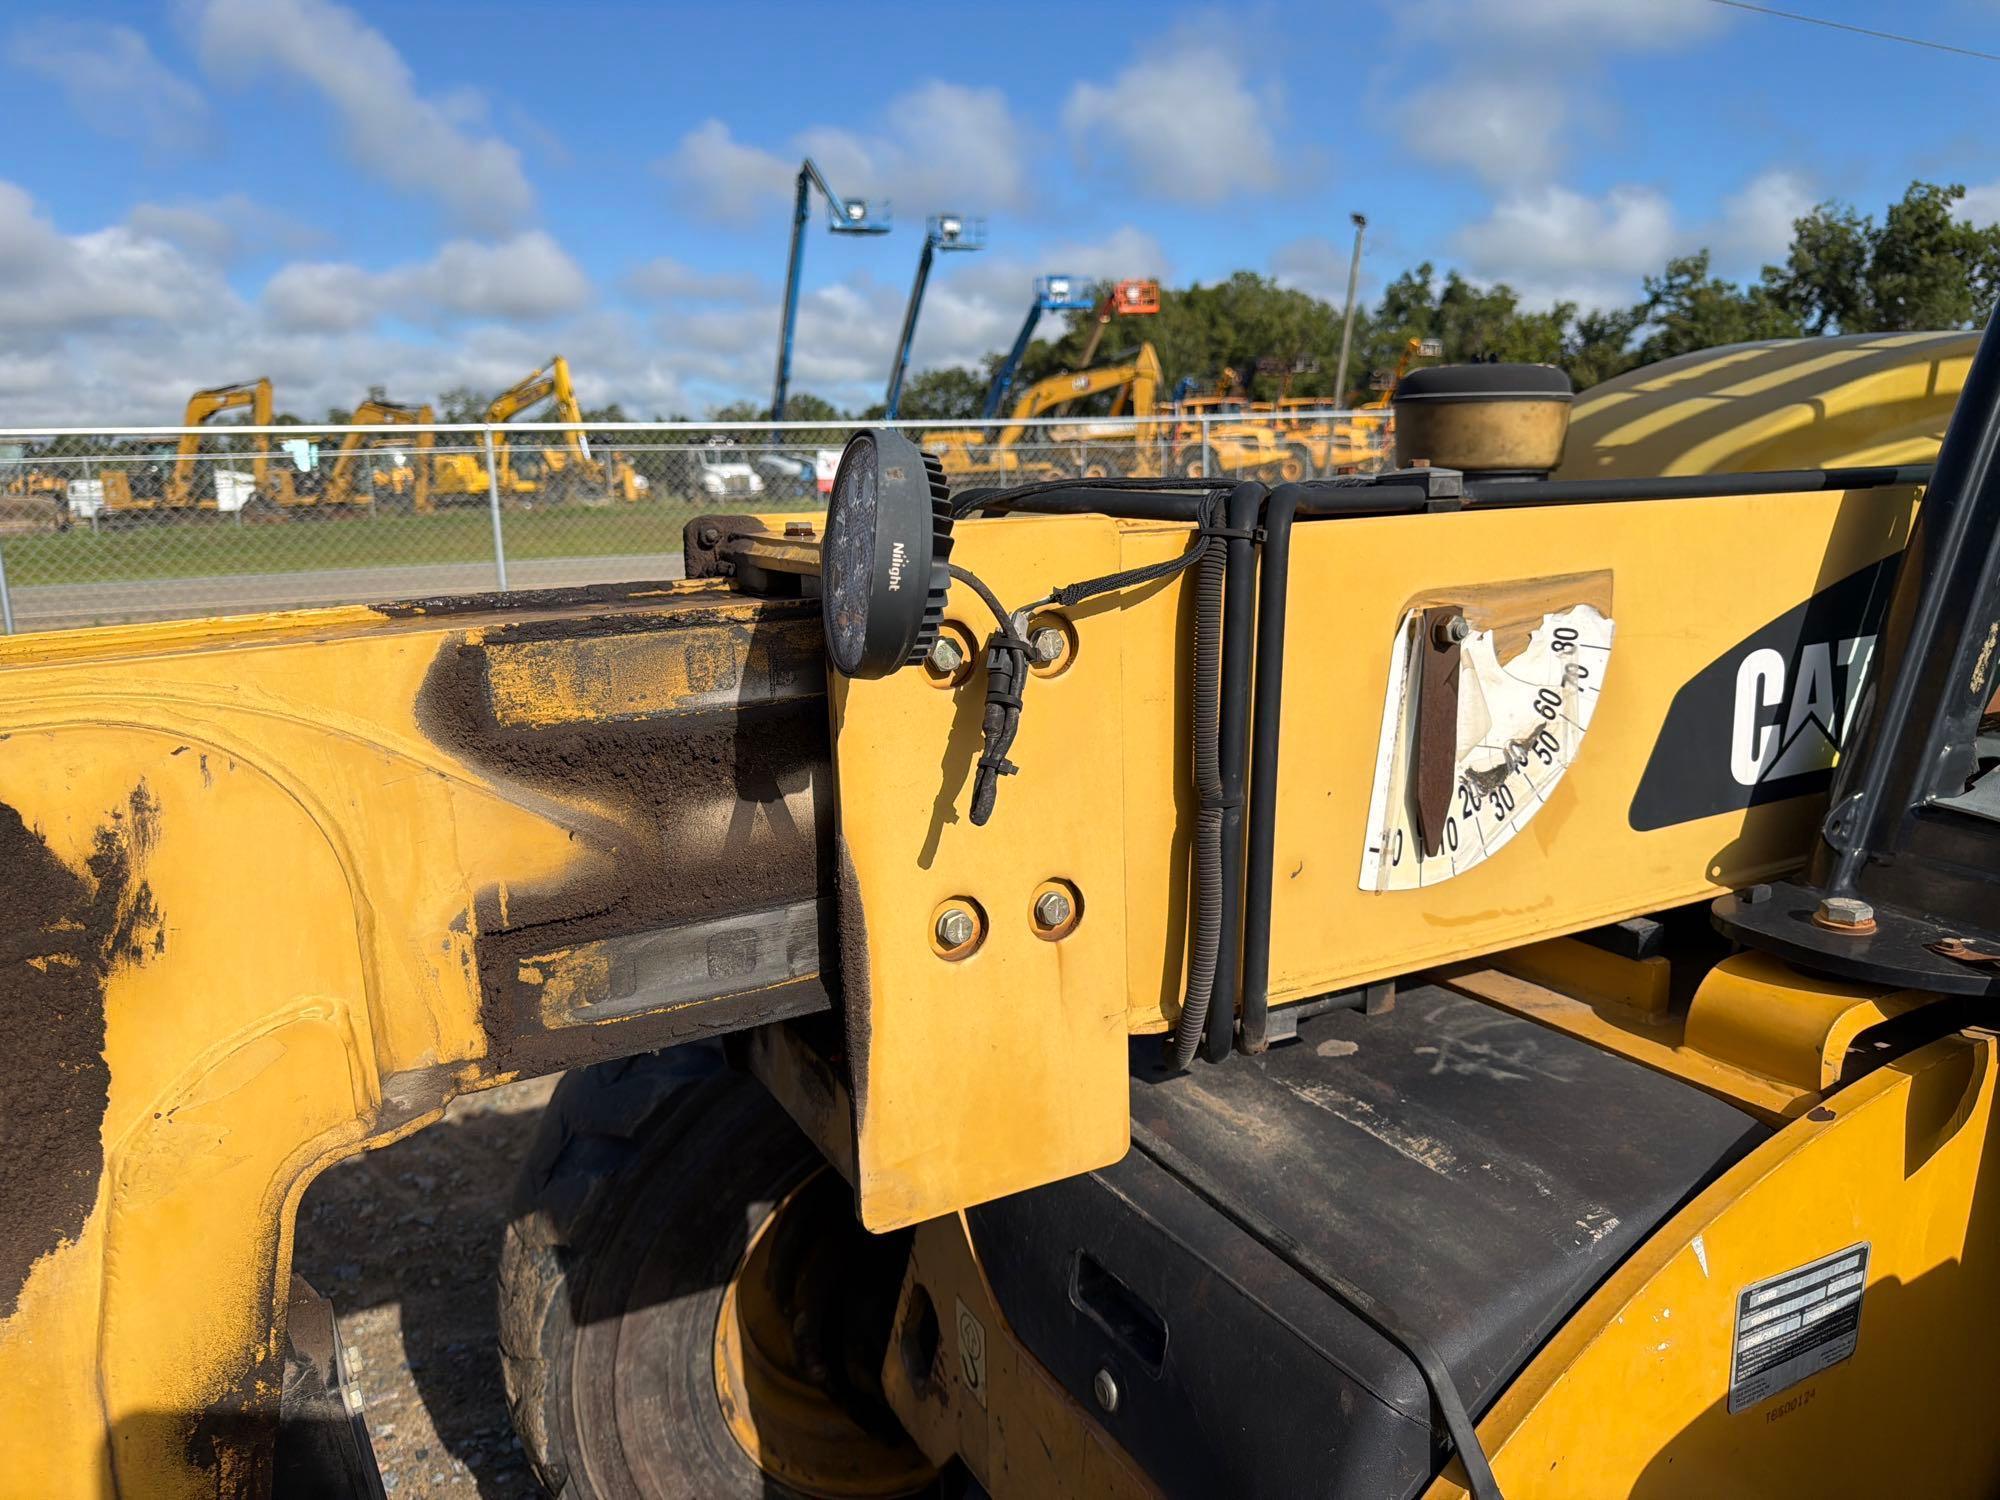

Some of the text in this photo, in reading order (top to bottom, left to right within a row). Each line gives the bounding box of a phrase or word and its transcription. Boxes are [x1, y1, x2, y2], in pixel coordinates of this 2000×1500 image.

[889, 542, 905, 592] Nilight
[1550, 627, 1579, 656] 80
[1560, 663, 1590, 693] 70
[1533, 688, 1563, 721] 60
[1532, 730, 1560, 765] 50
[1458, 779, 1482, 820] 20
[1489, 783, 1515, 822] 30
